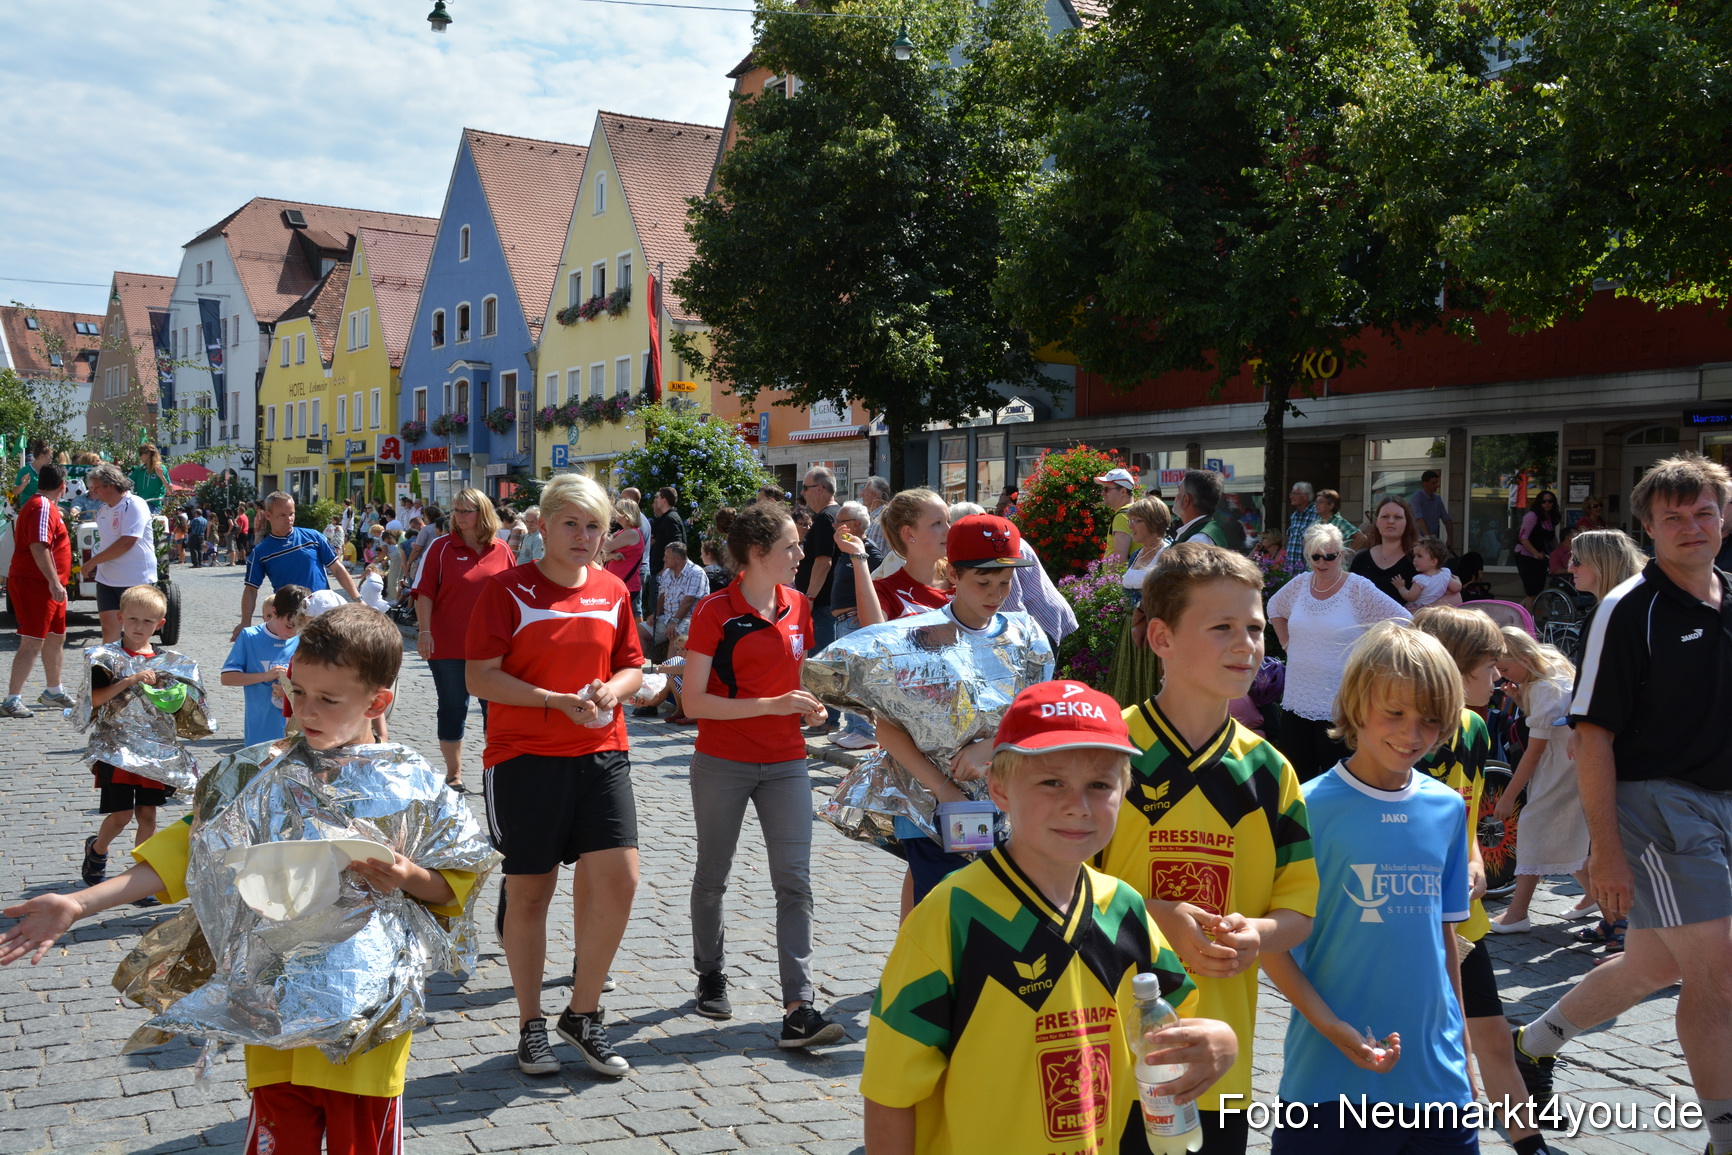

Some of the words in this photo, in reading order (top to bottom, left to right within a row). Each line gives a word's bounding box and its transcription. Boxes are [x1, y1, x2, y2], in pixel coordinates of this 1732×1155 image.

[1386, 349, 1479, 384] JOSEF
[288, 381, 305, 398] HOTEL
[520, 403, 530, 449] WITTL
[555, 447, 565, 466] P
[1680, 632, 1700, 643] JAKO
[1041, 701, 1107, 722] DEKRA
[1143, 801, 1171, 812] erima
[1380, 813, 1408, 823] JAKO
[1149, 829, 1235, 848] FRESSNAPF
[1380, 863, 1407, 872] Michael
[1407, 863, 1421, 872] und
[1374, 873, 1441, 896] FUCHS
[1018, 978, 1053, 995] erima
[1035, 1006, 1117, 1033] FRESSNAPF
